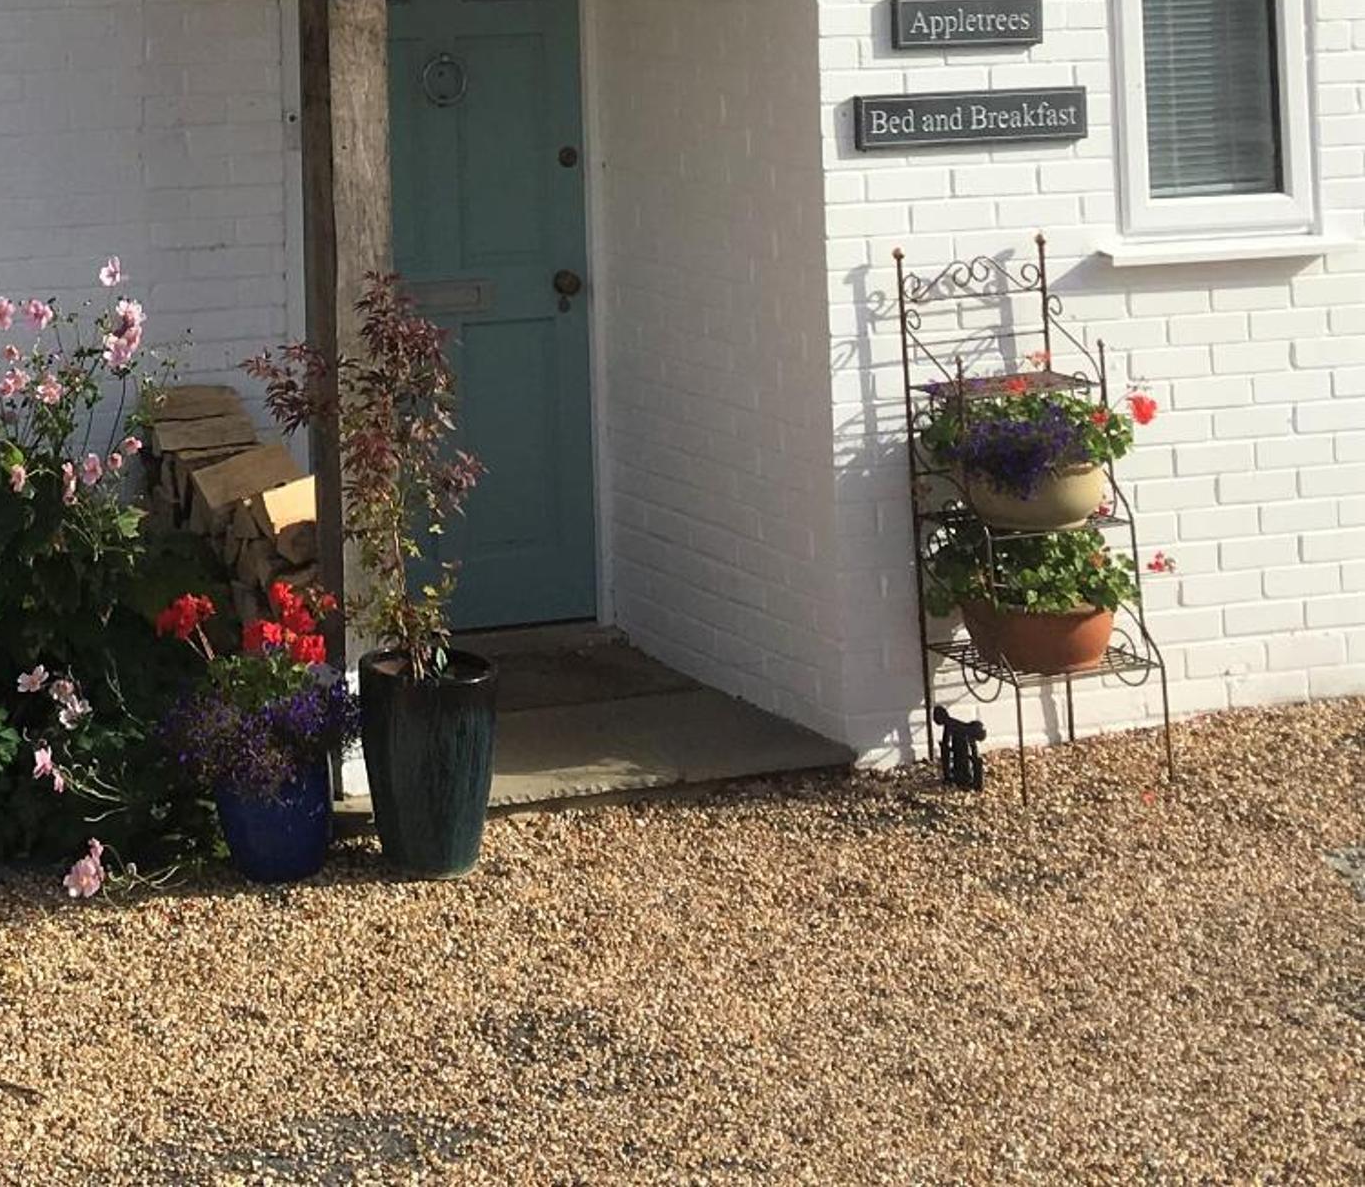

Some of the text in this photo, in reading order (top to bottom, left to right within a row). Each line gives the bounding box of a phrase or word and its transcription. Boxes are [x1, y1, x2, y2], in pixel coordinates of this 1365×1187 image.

[909, 8, 1031, 39] Appletrees
[870, 102, 1076, 134] Bed and Breakfast
